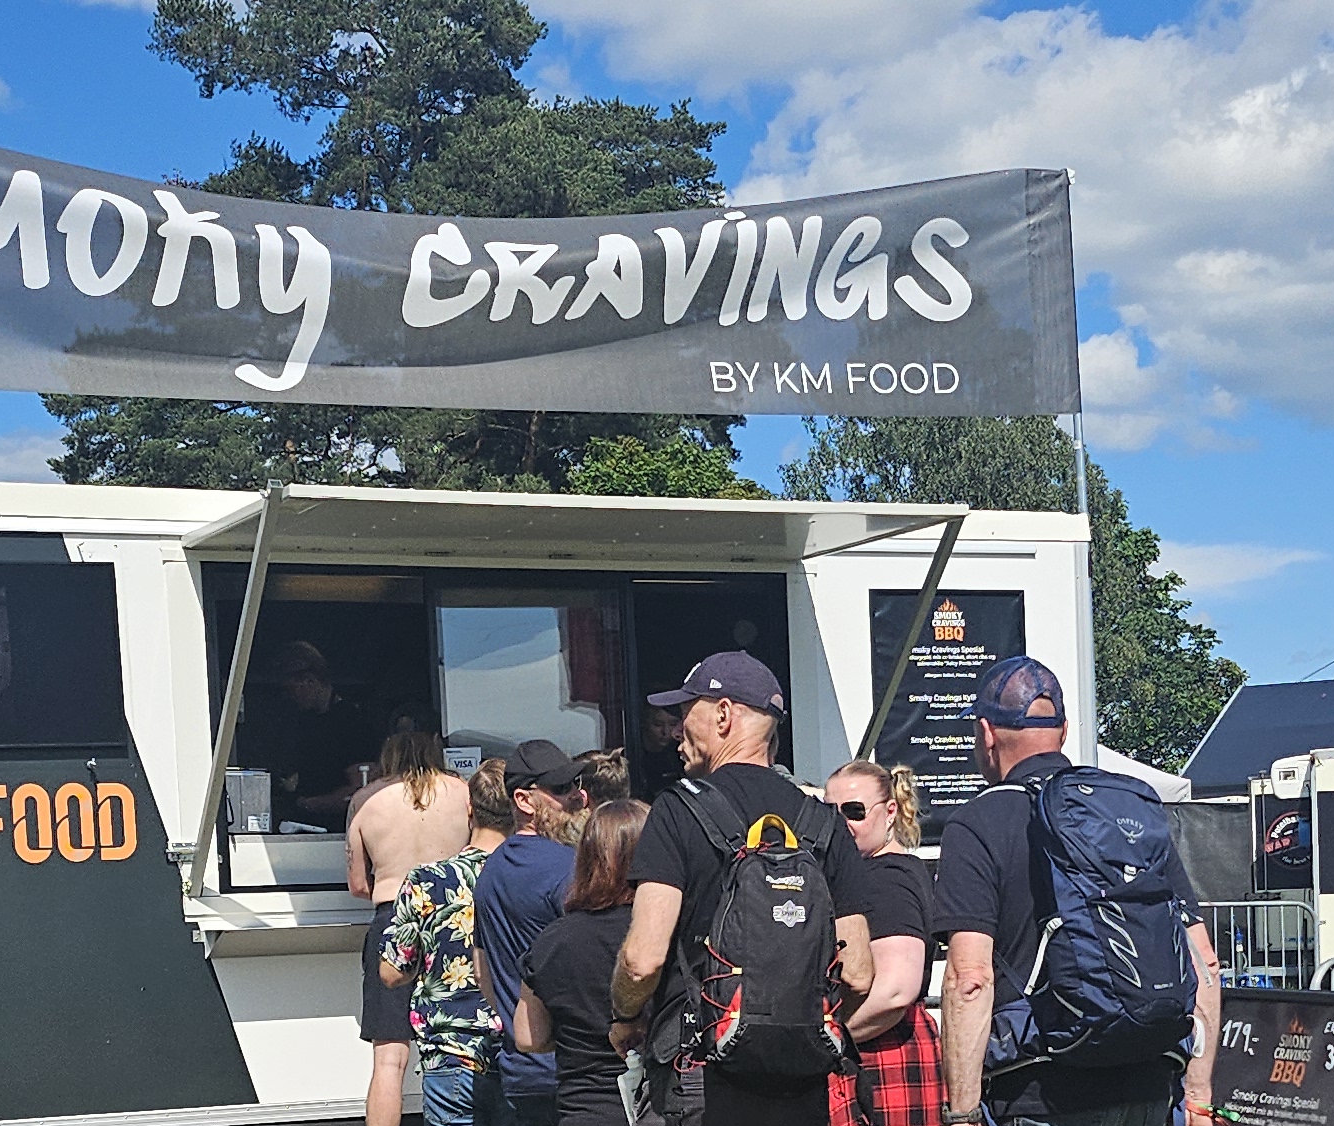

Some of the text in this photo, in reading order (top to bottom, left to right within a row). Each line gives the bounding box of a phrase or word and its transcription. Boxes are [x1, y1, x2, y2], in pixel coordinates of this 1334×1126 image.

[402, 211, 972, 328] CRAVINGS
[709, 361, 960, 395] BY KM FOOD
[931, 619, 965, 627] CRAVINGS
[933, 611, 963, 620] SMOKY
[934, 627, 964, 642] BBQ
[454, 760, 473, 769] VISA
[1279, 1033, 1313, 1050] SMOKY
[1273, 1046, 1312, 1062] CRAVINGS
[1269, 1059, 1306, 1088] BBQ
[1232, 1088, 1258, 1104] Smoky
[1259, 1092, 1292, 1108] Cravings
